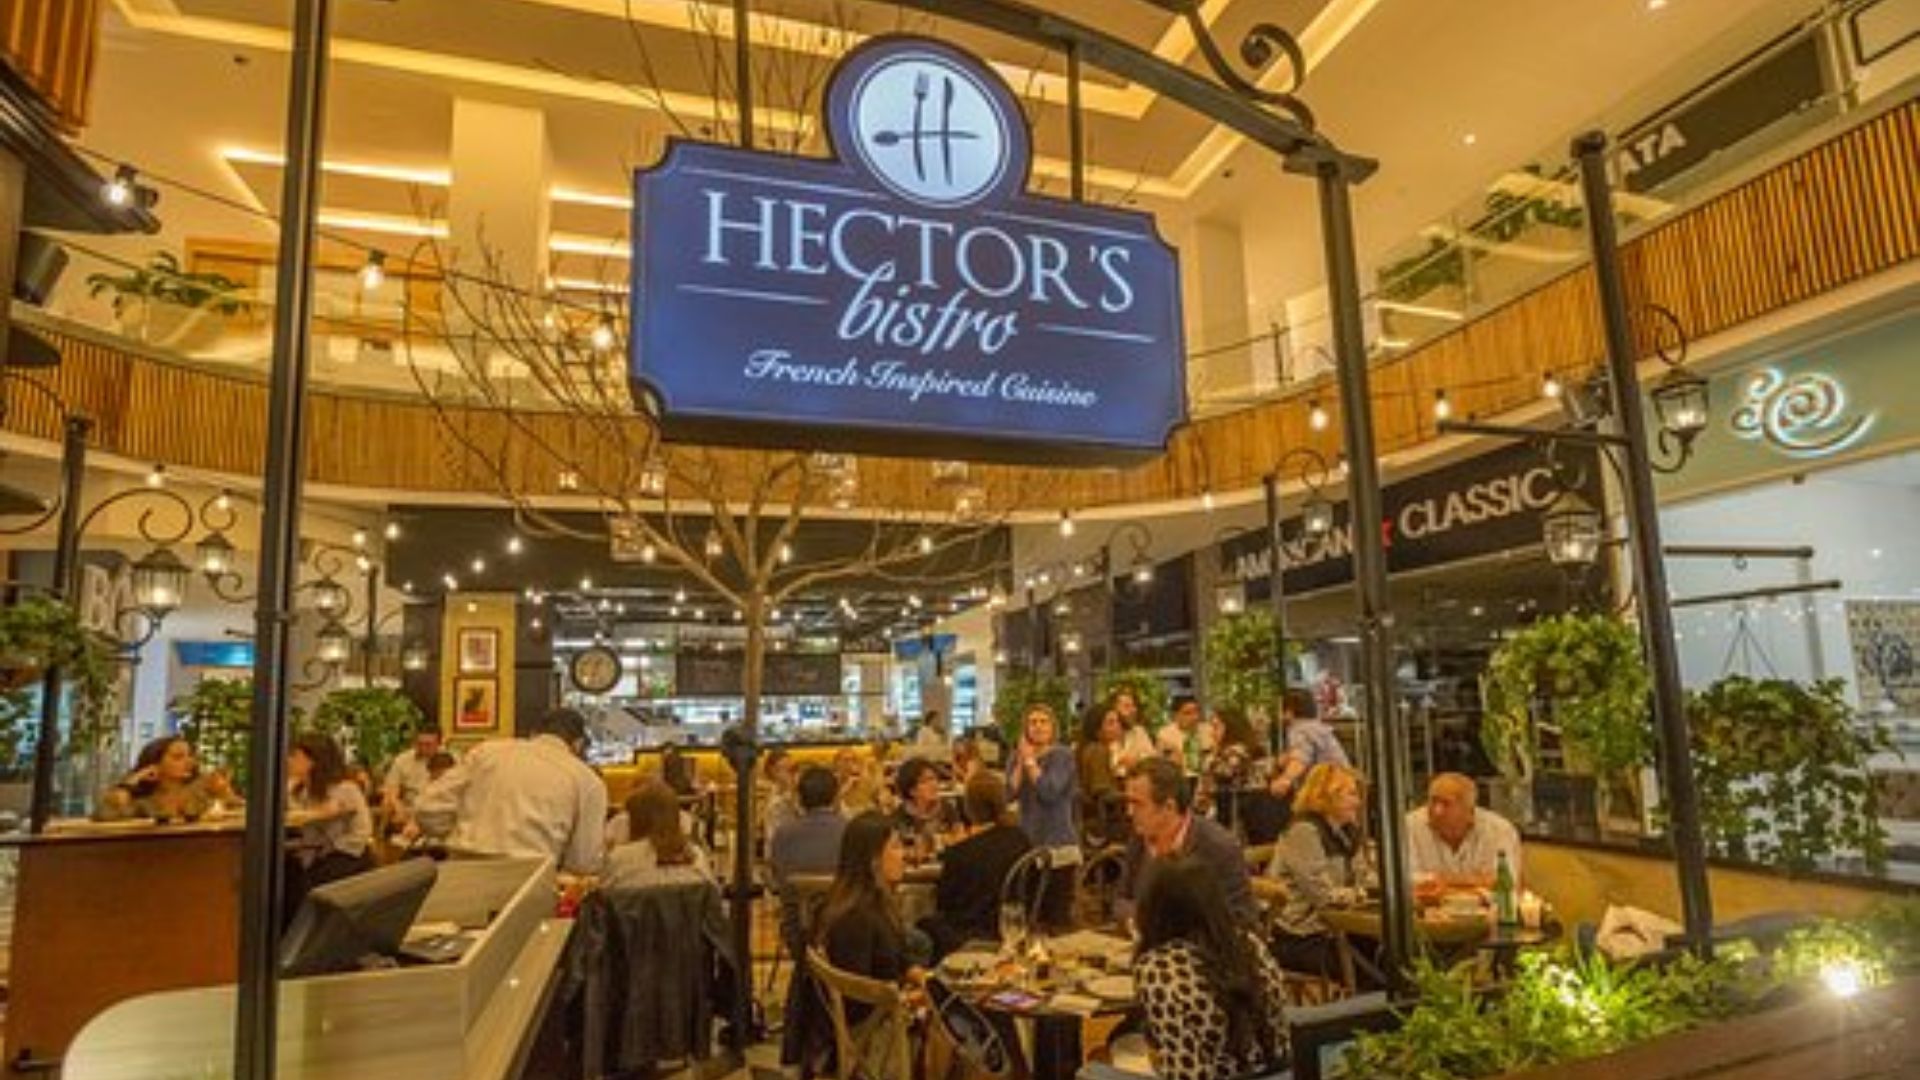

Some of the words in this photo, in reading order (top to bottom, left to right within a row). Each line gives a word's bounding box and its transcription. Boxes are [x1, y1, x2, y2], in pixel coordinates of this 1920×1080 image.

[704, 190, 1134, 312] HECTOR'S
[838, 261, 1017, 353] bistro
[744, 349, 858, 386] French
[864, 361, 995, 402] Inspired
[1001, 372, 1098, 406] Cuisine
[1400, 467, 1558, 539] CLASSIC
